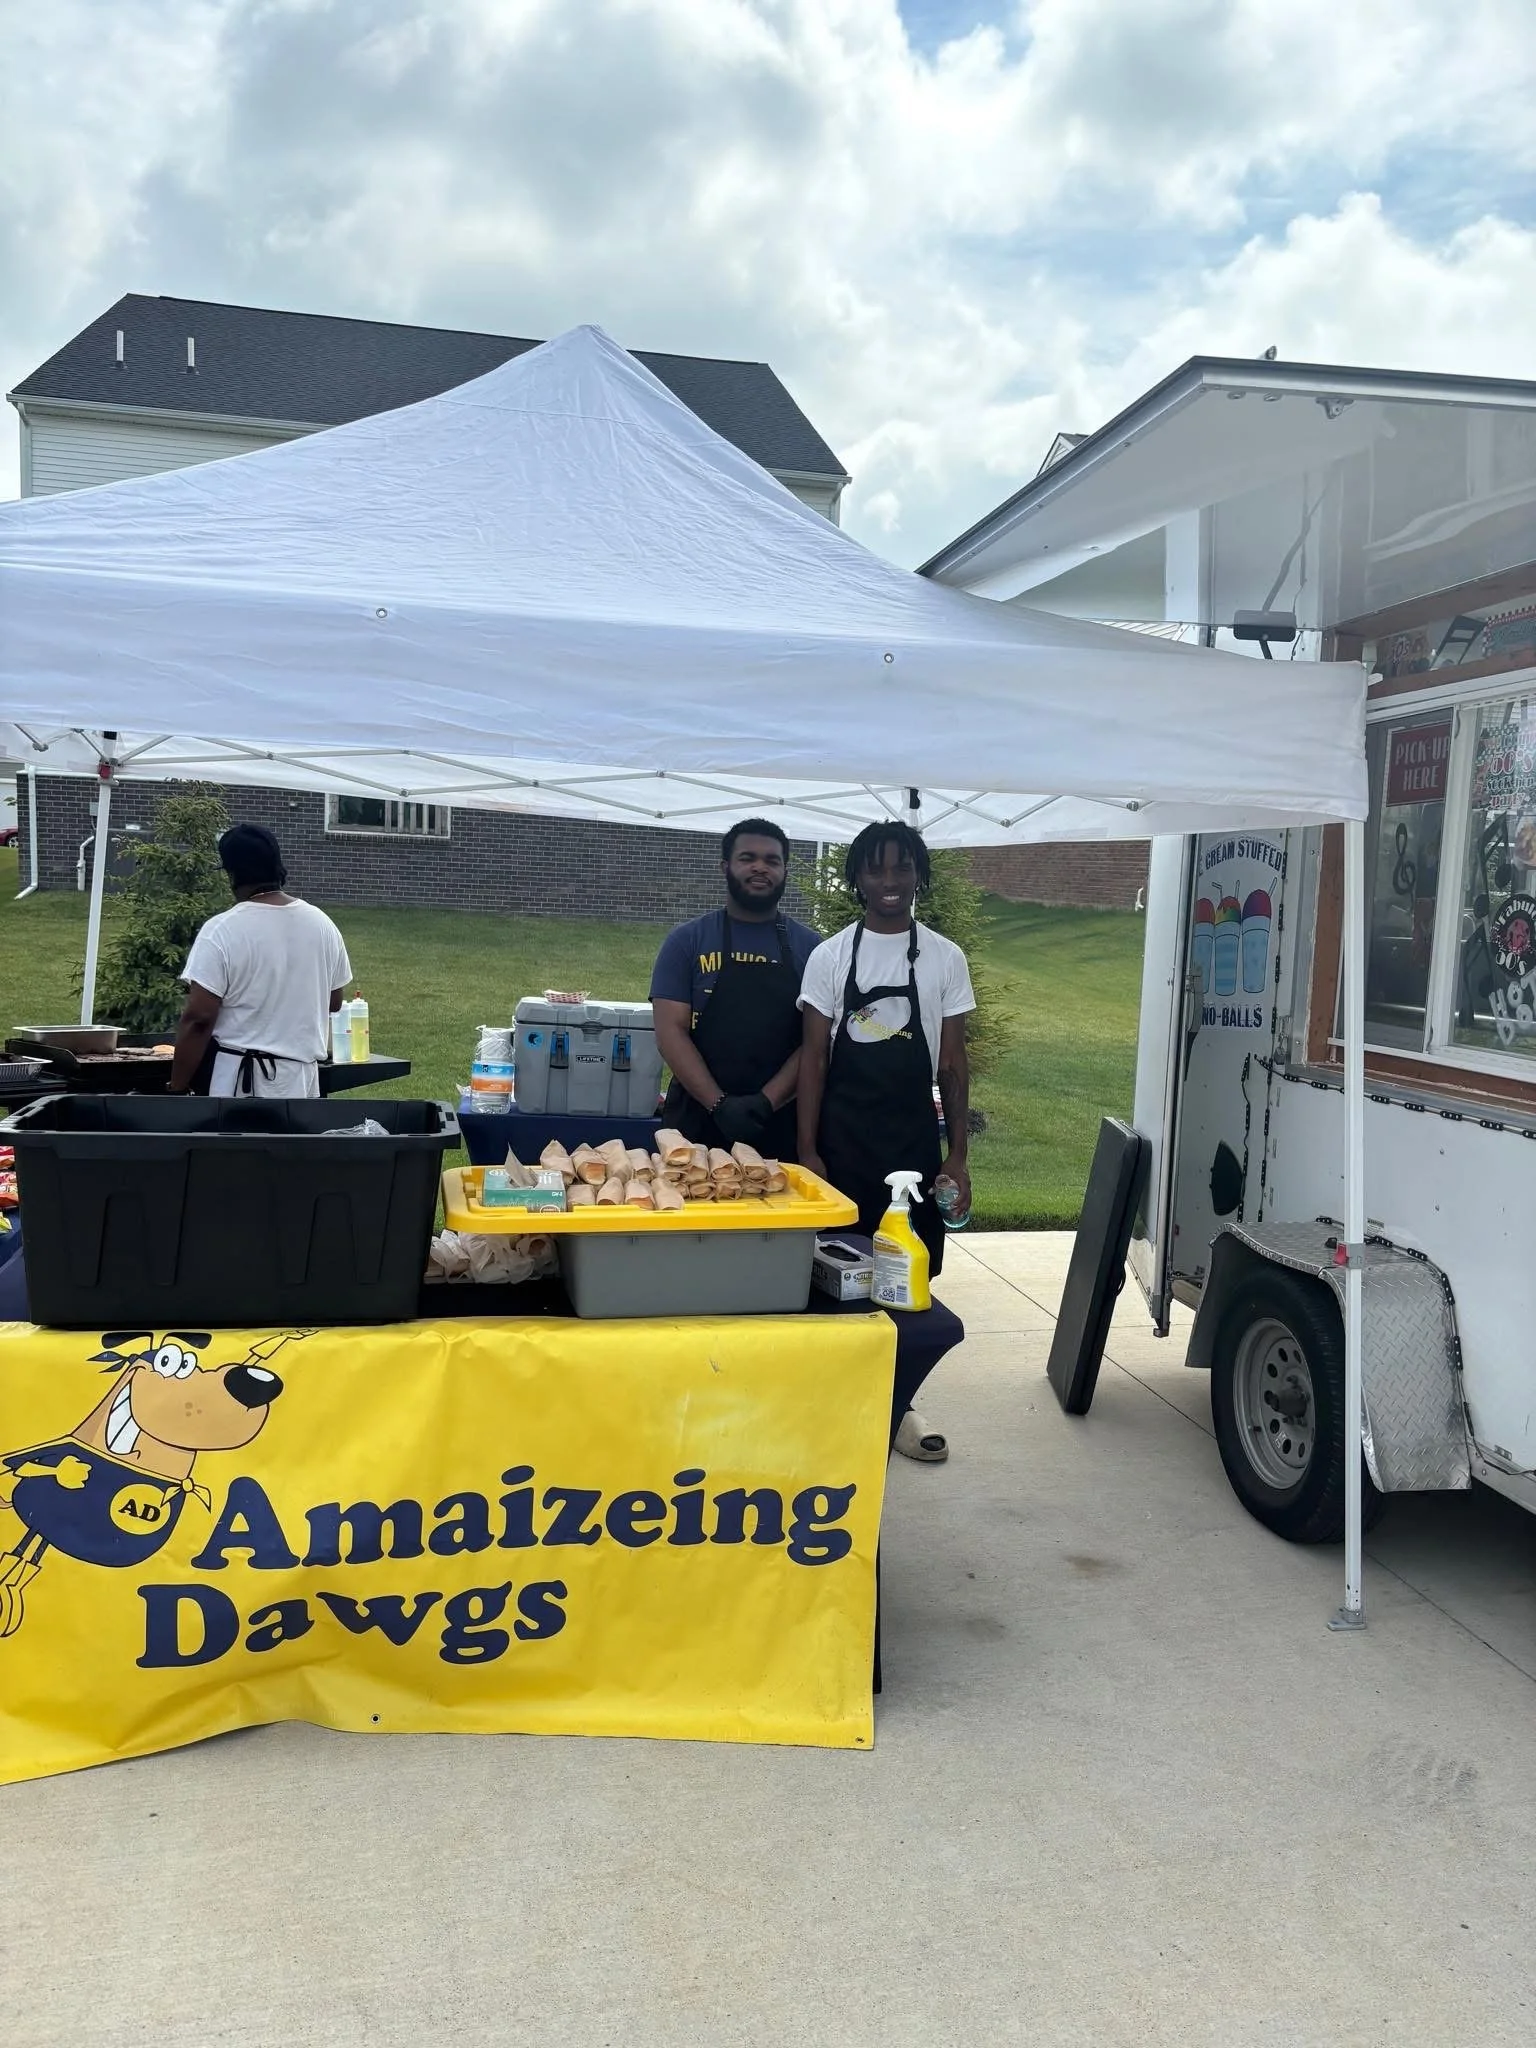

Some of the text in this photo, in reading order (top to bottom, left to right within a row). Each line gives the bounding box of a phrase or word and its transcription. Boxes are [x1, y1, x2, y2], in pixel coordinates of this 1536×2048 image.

[1402, 765, 1440, 792] HERE
[1205, 841, 1235, 870] CREAM
[1237, 839, 1284, 874] STUFFED
[118, 1498, 161, 1522] AD
[191, 1466, 858, 1570] Amaizeing
[135, 1579, 568, 1667] Dawgs
